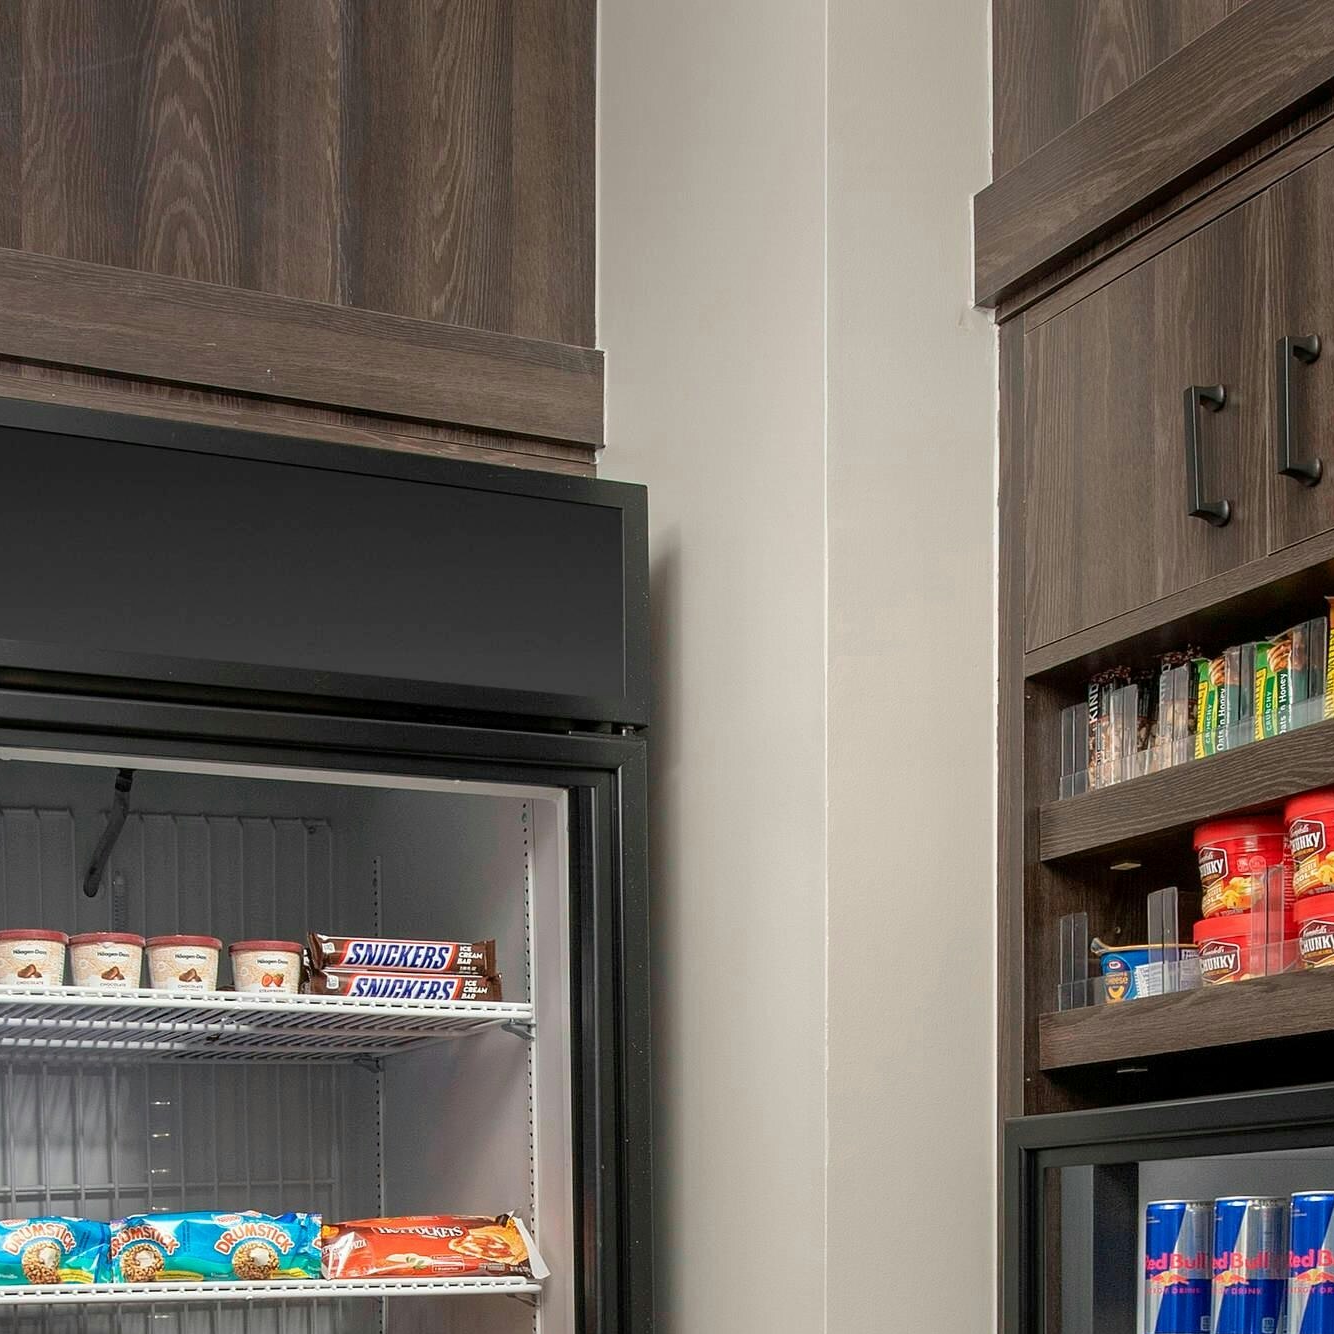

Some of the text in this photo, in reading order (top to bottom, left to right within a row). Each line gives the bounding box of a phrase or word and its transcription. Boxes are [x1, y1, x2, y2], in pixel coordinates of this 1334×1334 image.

[1088, 683, 1100, 724] KIND
[347, 943, 450, 968] SNICKERS
[5, 1224, 76, 1255] DRUMSTICK
[214, 1224, 294, 1254] DRUMSTICK
